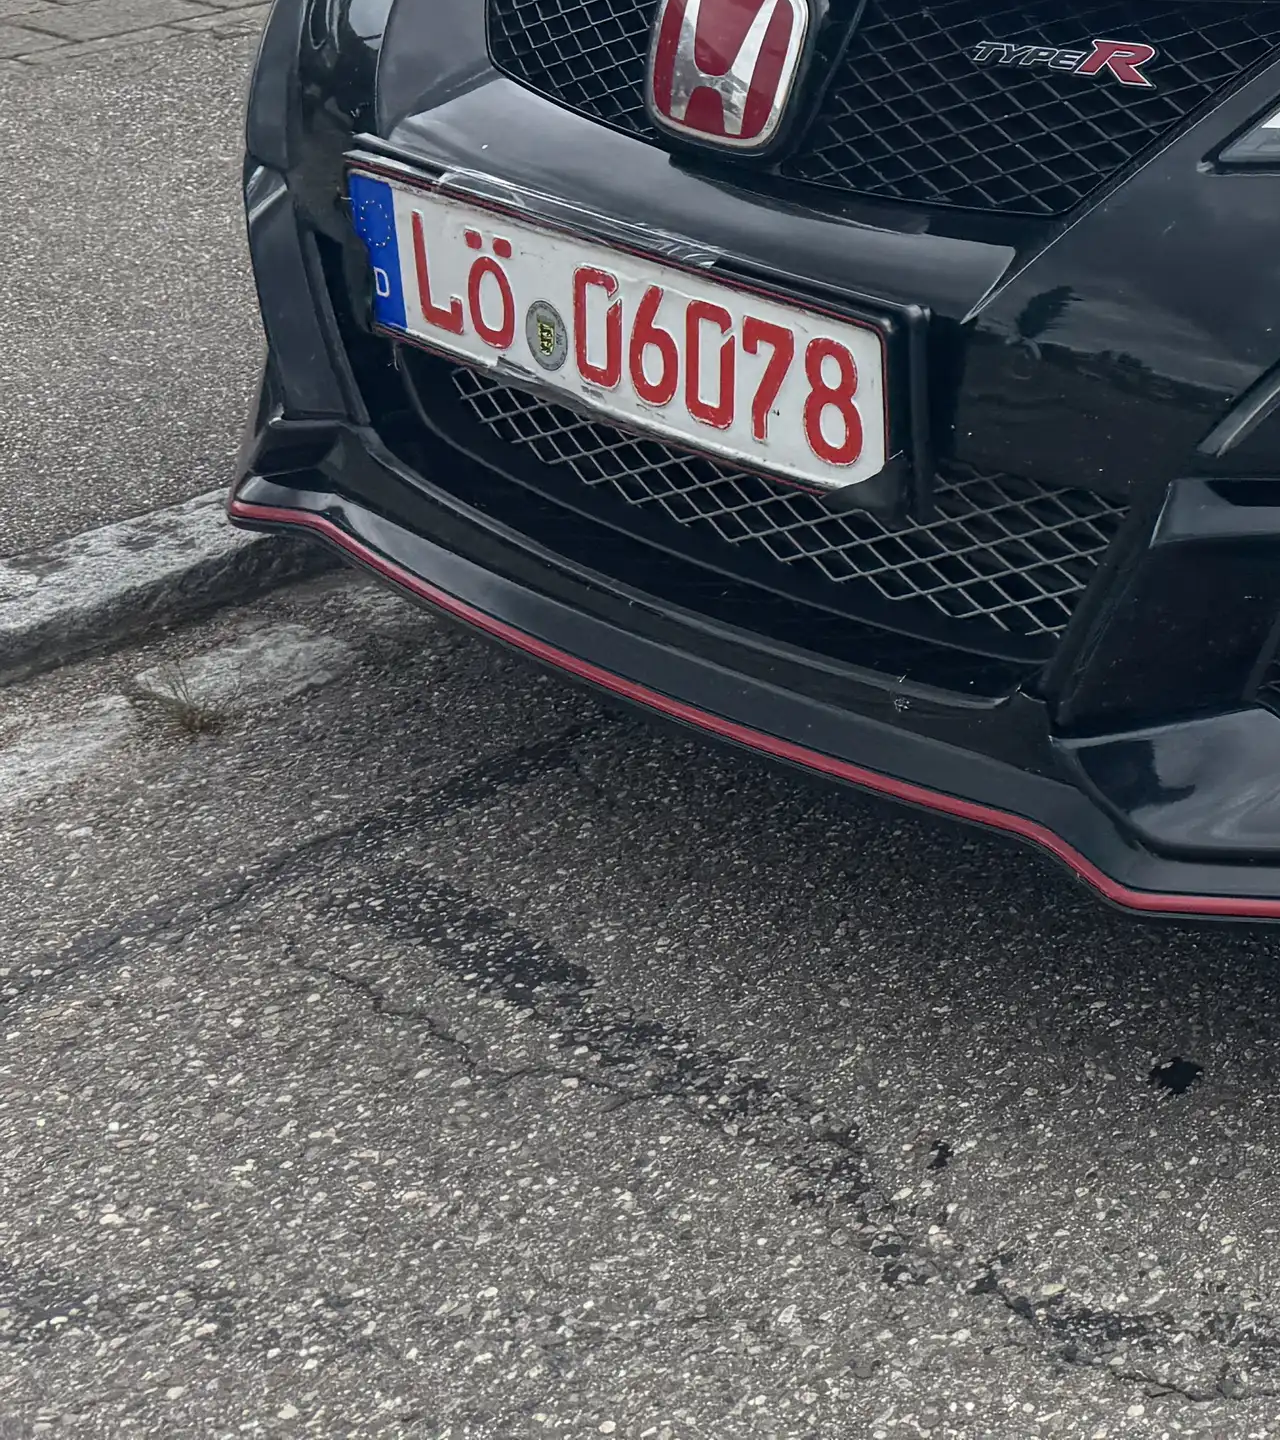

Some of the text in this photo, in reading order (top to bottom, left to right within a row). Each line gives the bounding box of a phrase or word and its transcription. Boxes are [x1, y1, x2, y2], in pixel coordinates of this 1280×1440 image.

[373, 266, 390, 298] D
[411, 210, 515, 349] LÖ
[573, 265, 863, 466] 06078
